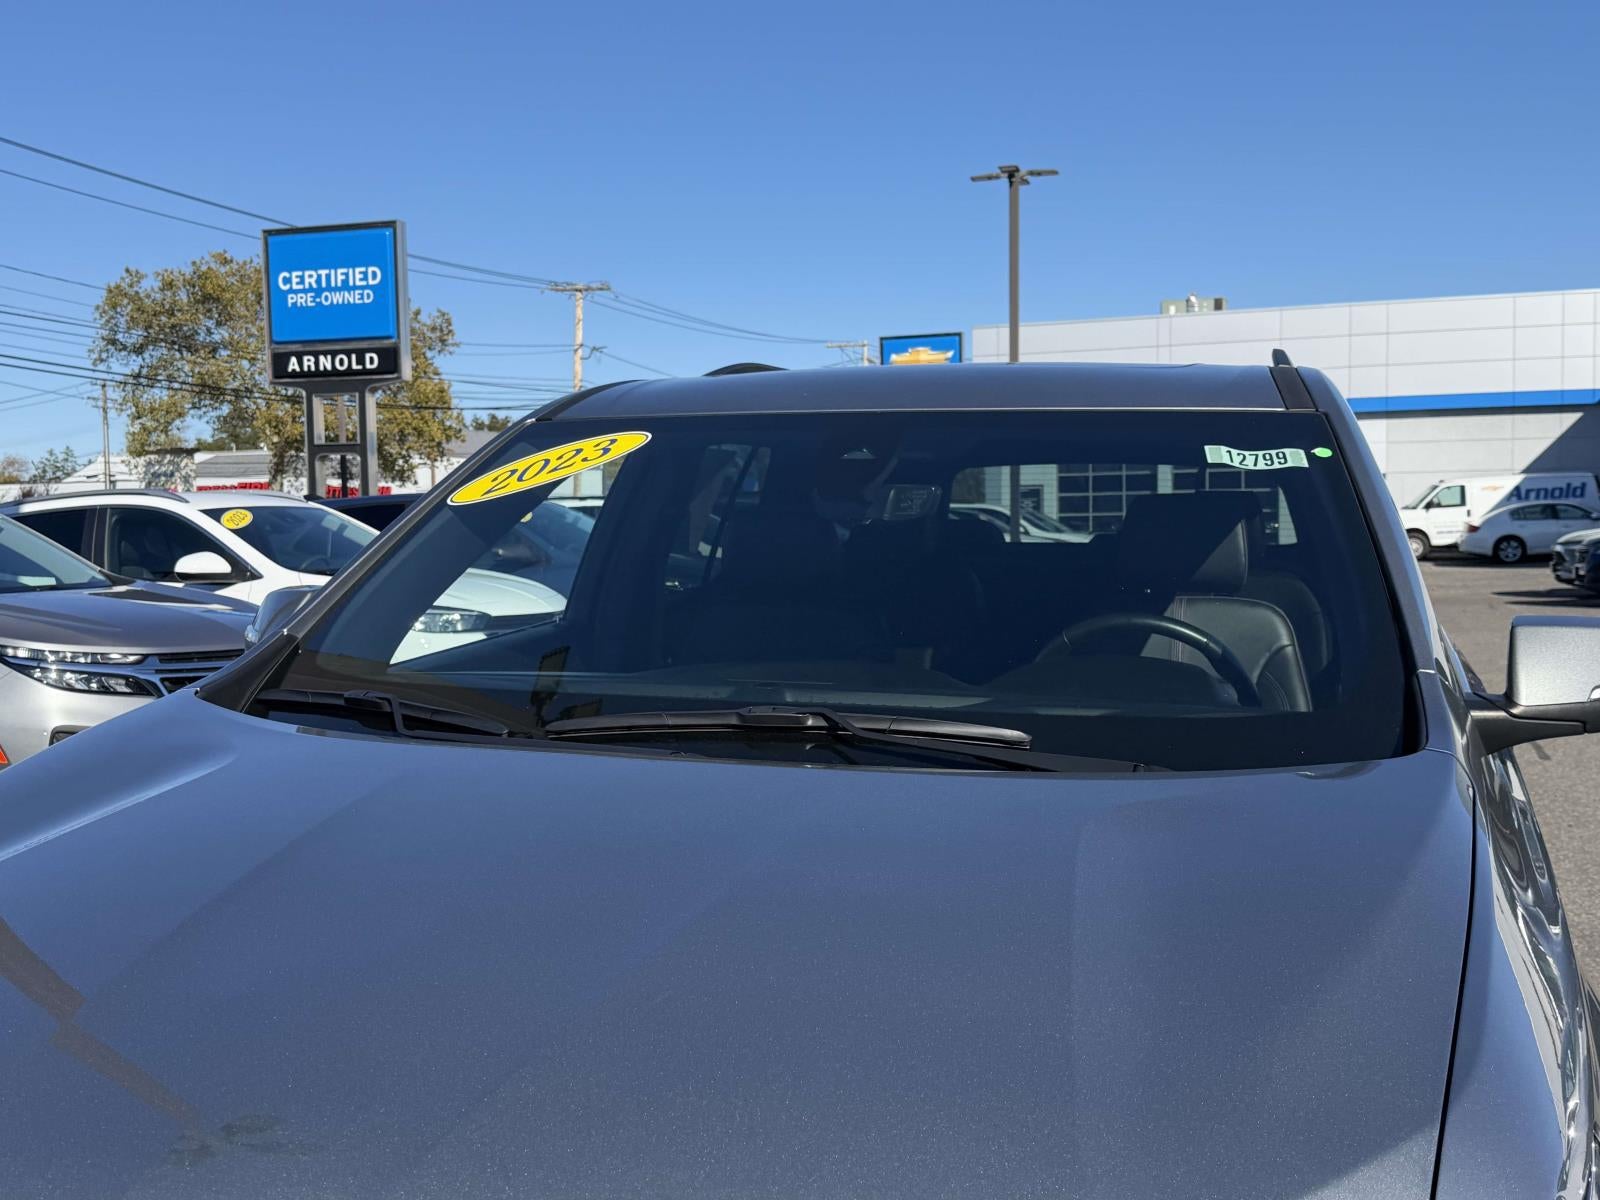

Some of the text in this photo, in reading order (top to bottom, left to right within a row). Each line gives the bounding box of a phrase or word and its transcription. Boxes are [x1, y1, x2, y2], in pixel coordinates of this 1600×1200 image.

[278, 266, 382, 291] CERTIFIED
[287, 289, 374, 308] PRE-OWNED
[287, 352, 379, 373] ARNOLD
[480, 438, 618, 498] 2023
[1226, 450, 1288, 468] 12799
[1507, 482, 1587, 501] Arnold
